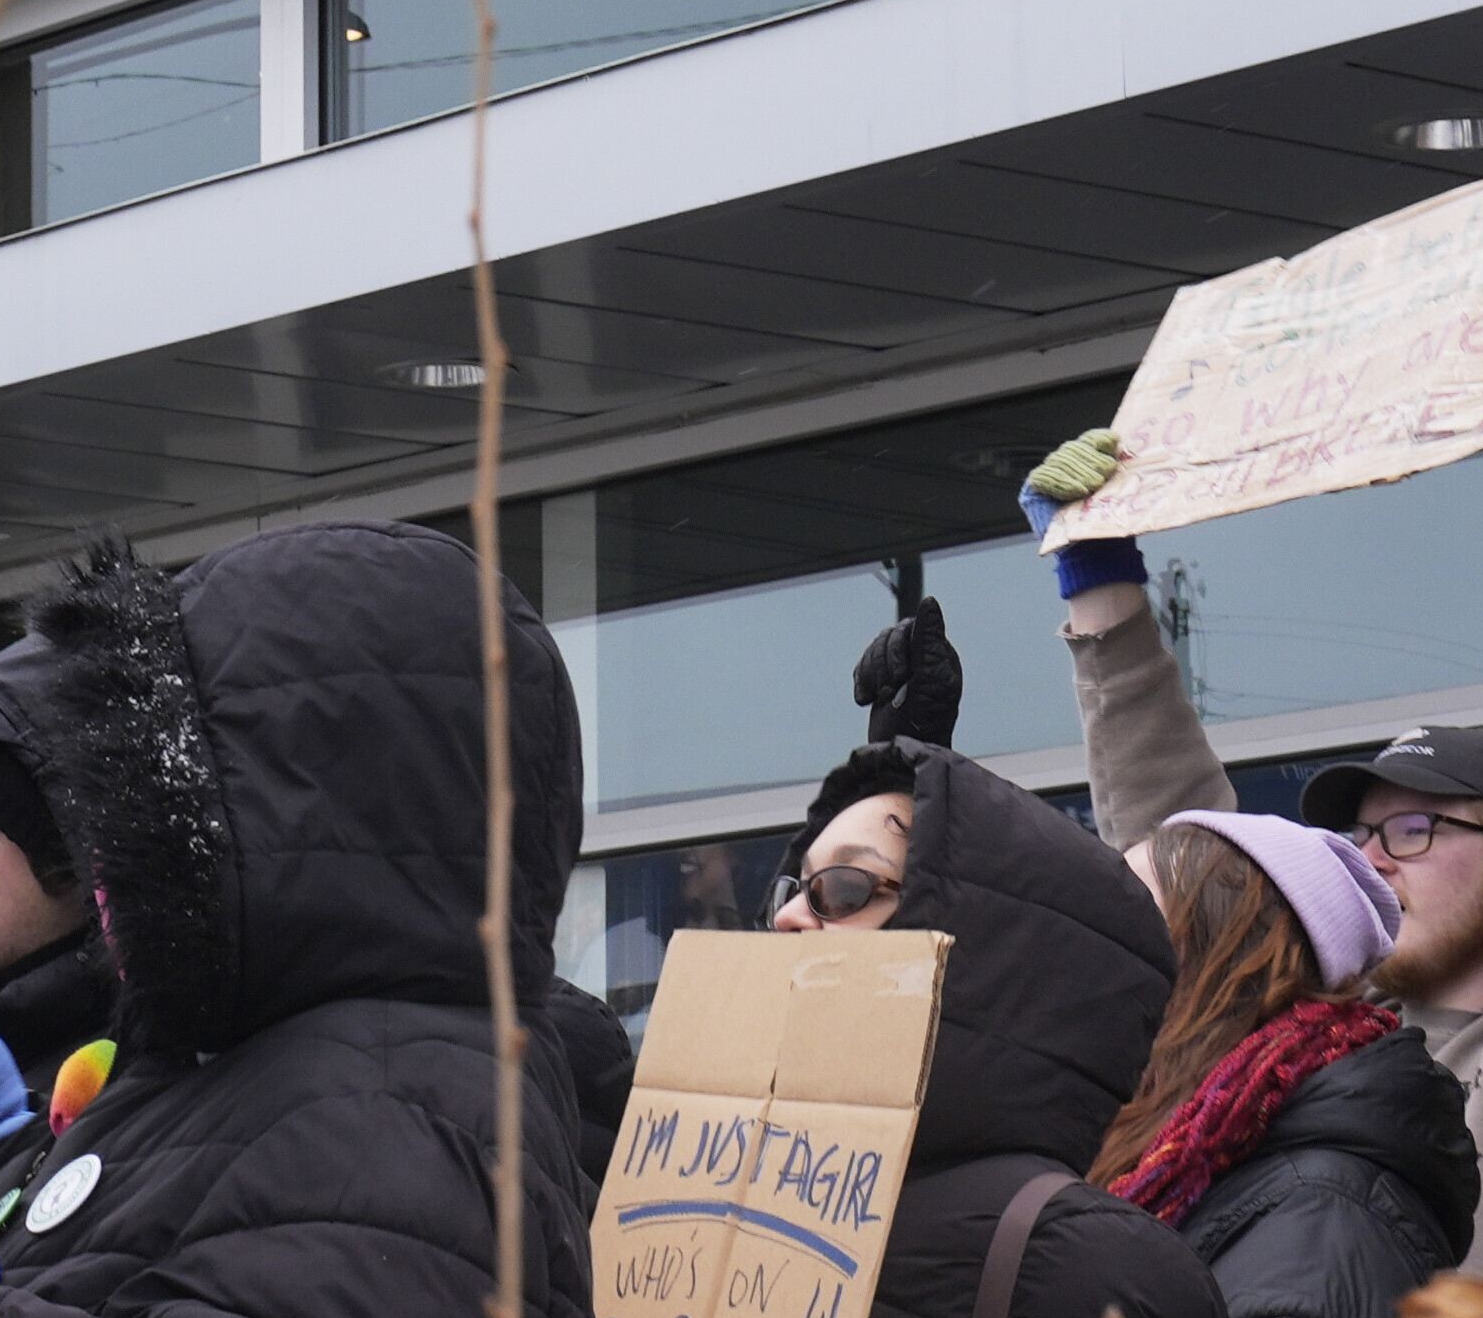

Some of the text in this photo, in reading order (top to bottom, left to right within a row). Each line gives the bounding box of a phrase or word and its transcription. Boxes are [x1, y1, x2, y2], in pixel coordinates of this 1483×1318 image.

[624, 1108, 678, 1178] I'M
[678, 1114, 791, 1187] JUST
[616, 1229, 790, 1315] WHO'S ON
